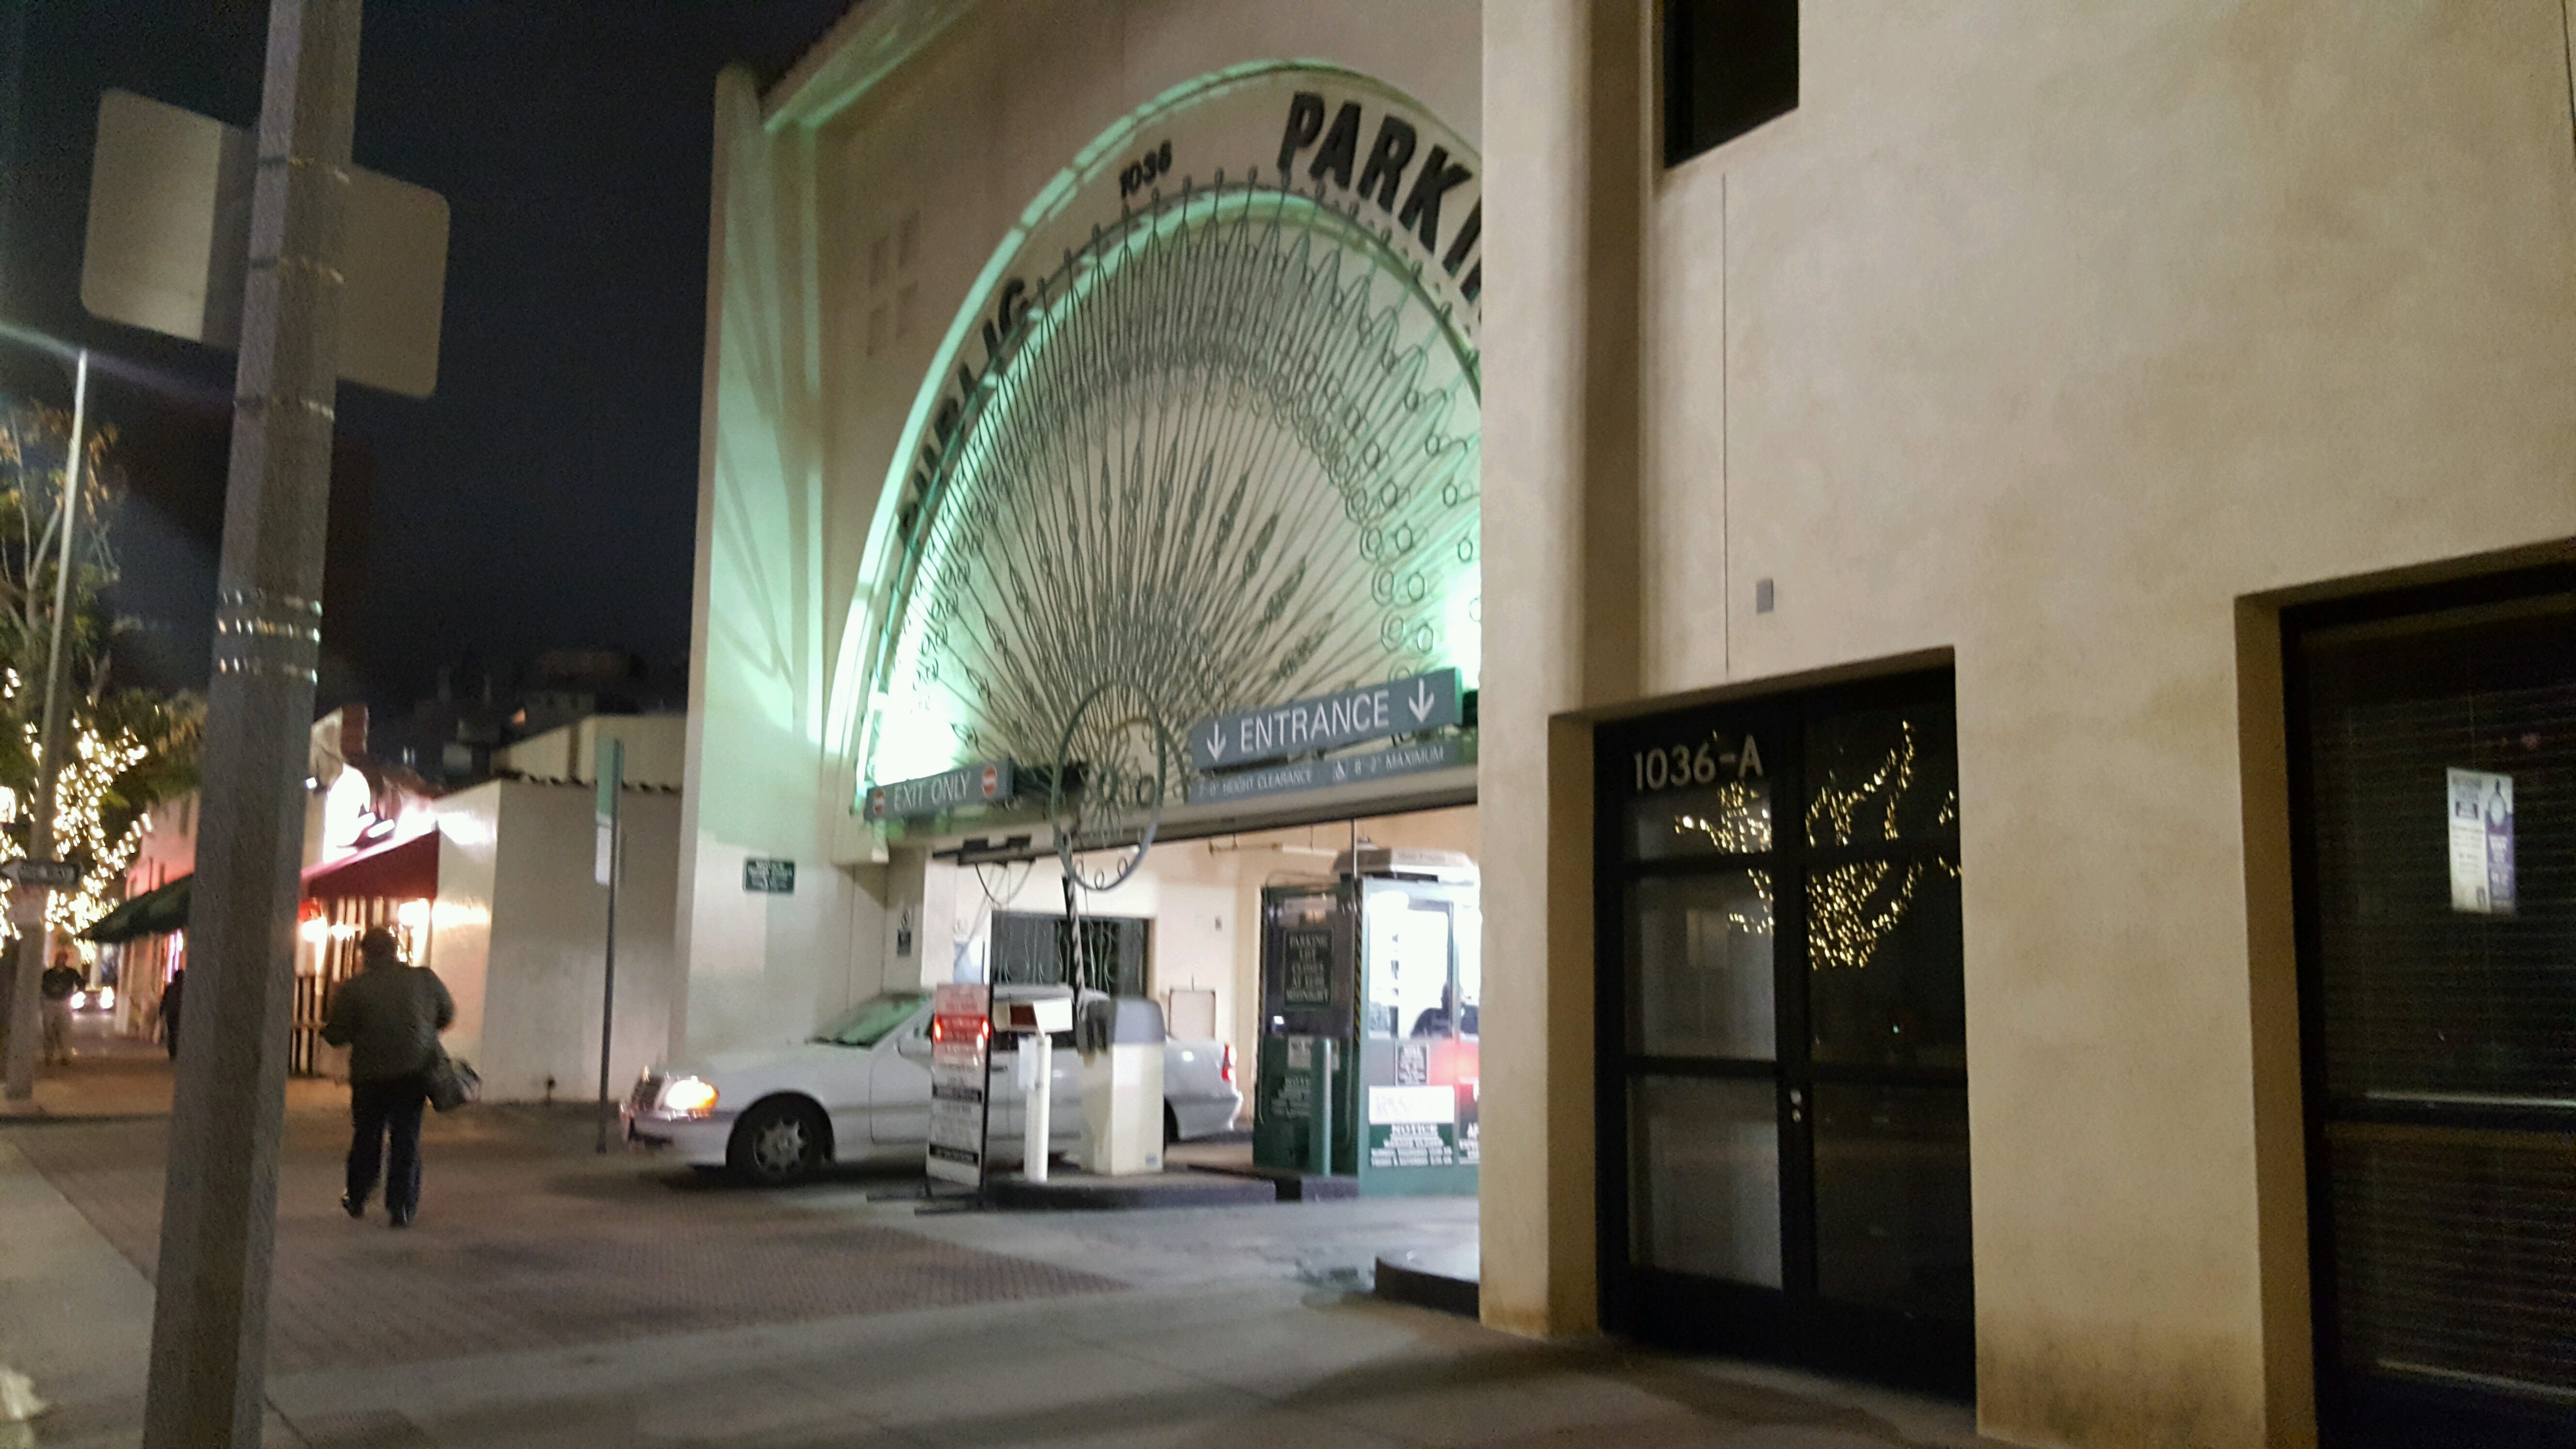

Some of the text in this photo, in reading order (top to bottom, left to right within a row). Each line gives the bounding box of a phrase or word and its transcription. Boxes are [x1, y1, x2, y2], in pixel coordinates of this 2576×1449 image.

[1120, 139, 1172, 200] 1036
[1240, 689, 1389, 753] ENTRANCE
[1385, 745, 1445, 771] MAXIMUM
[1634, 734, 1764, 791] 1036-A
[894, 771, 970, 811] EXIT ONLY
